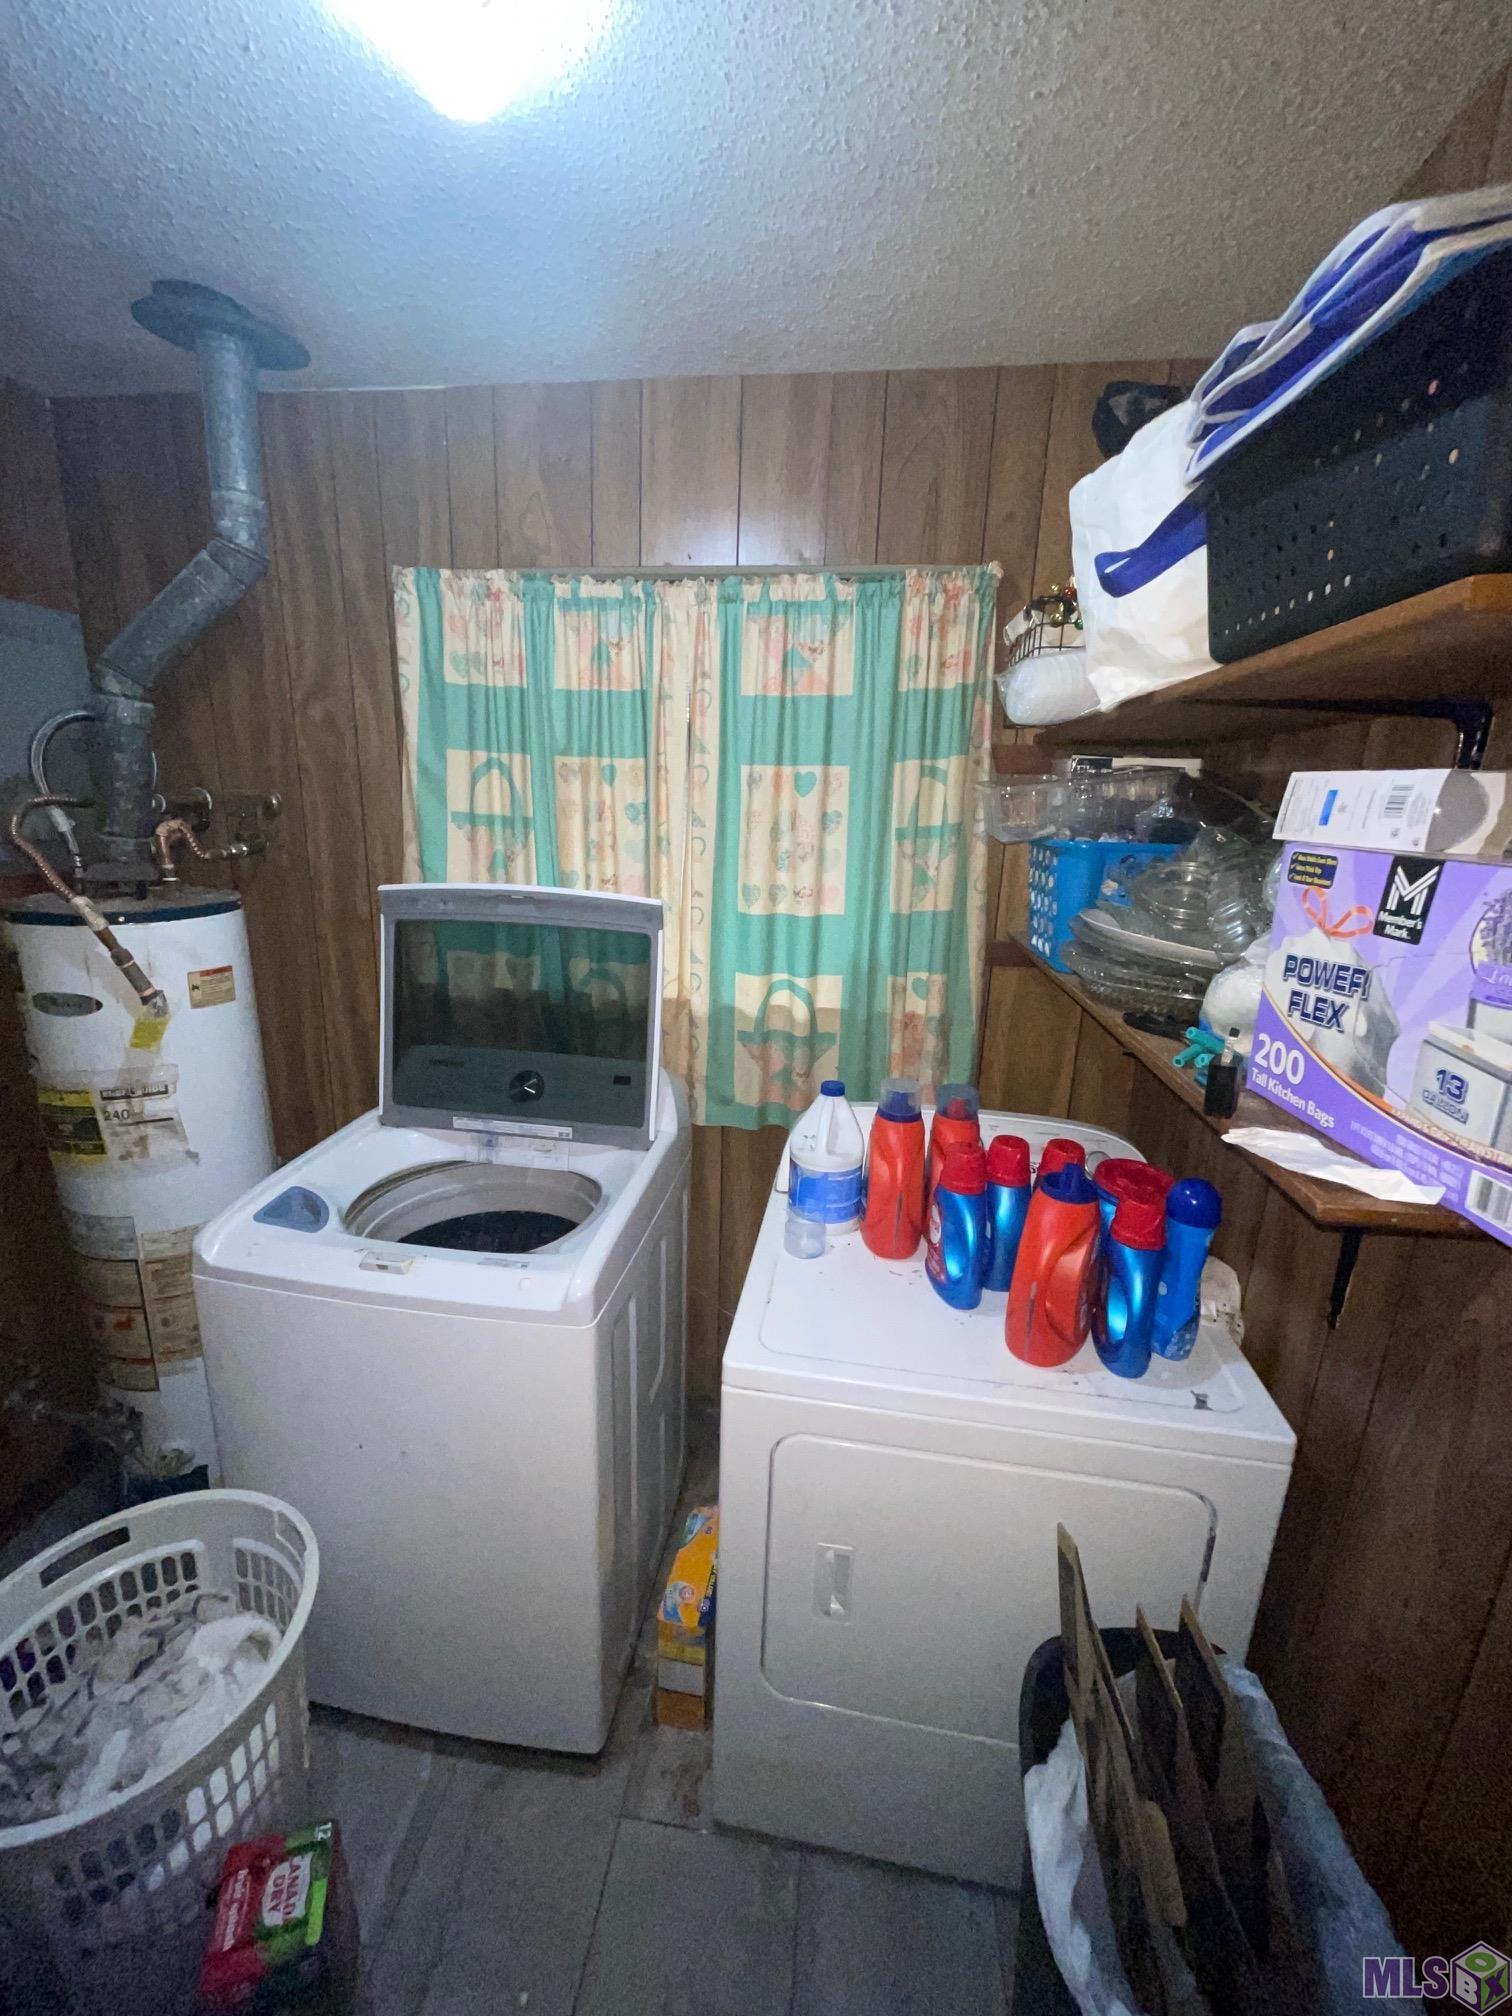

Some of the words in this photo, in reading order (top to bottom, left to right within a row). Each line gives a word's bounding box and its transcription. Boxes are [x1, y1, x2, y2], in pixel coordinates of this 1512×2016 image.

[1379, 910, 1423, 930] Member's
[1283, 954, 1372, 1000] POWER
[1287, 989, 1350, 1034] FLEX
[1254, 1033, 1305, 1085] 200
[1252, 1067, 1268, 1088] Tall
[1267, 1076, 1307, 1111] Kitchen
[1307, 1100, 1336, 1128] Bags
[1436, 1068, 1470, 1105] 13
[270, 1874, 286, 1912] DRY
